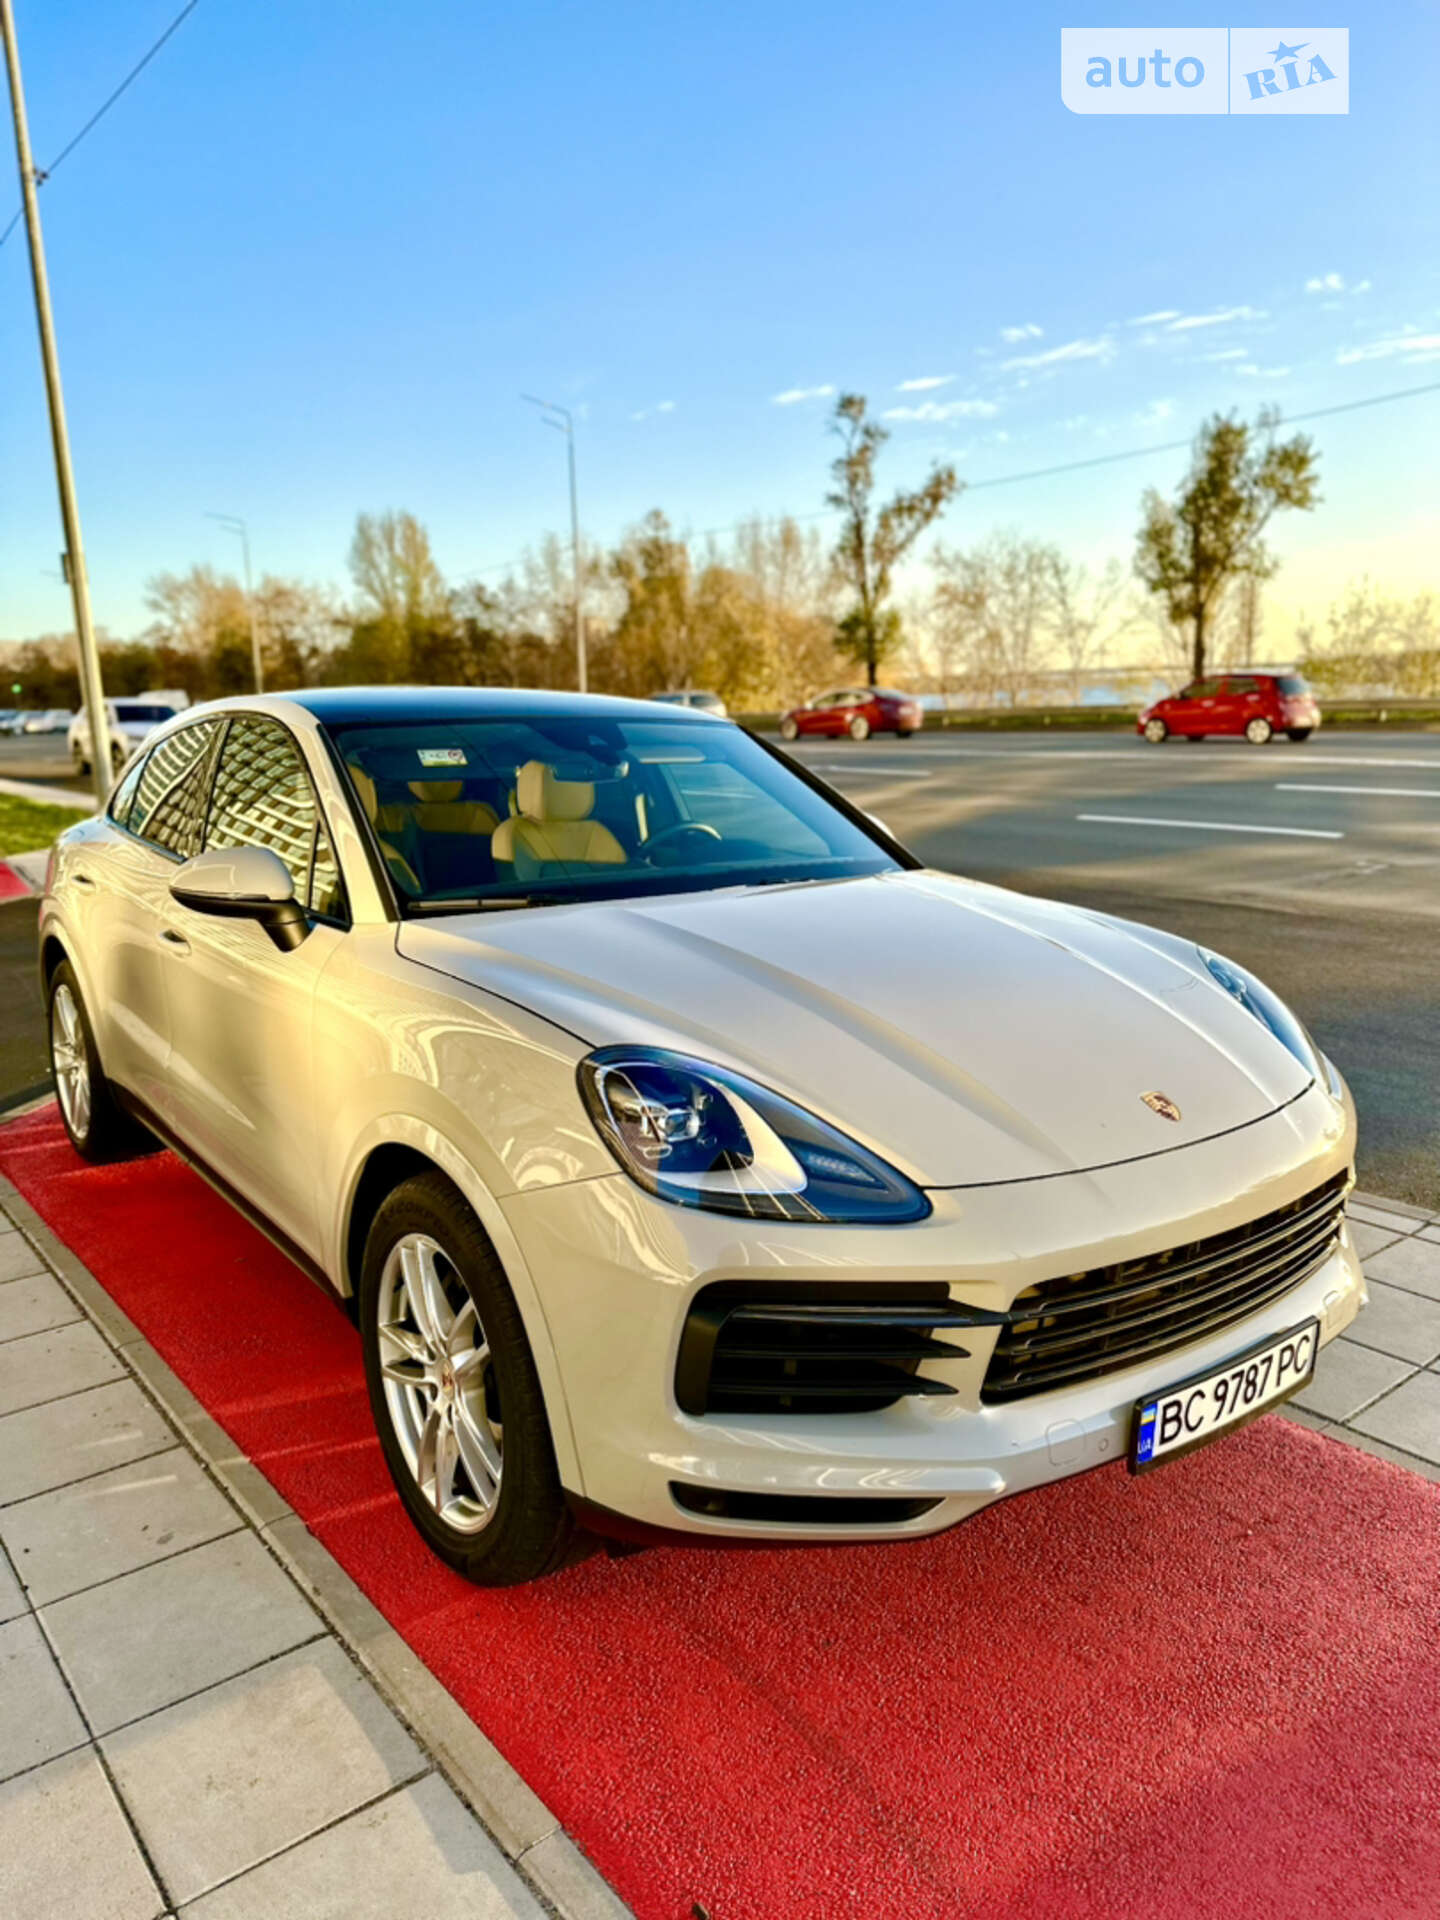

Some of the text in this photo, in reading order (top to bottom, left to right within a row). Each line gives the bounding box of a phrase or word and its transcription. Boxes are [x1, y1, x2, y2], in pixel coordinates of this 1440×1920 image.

[1159, 1335, 1310, 1446] BC 9787 PC
